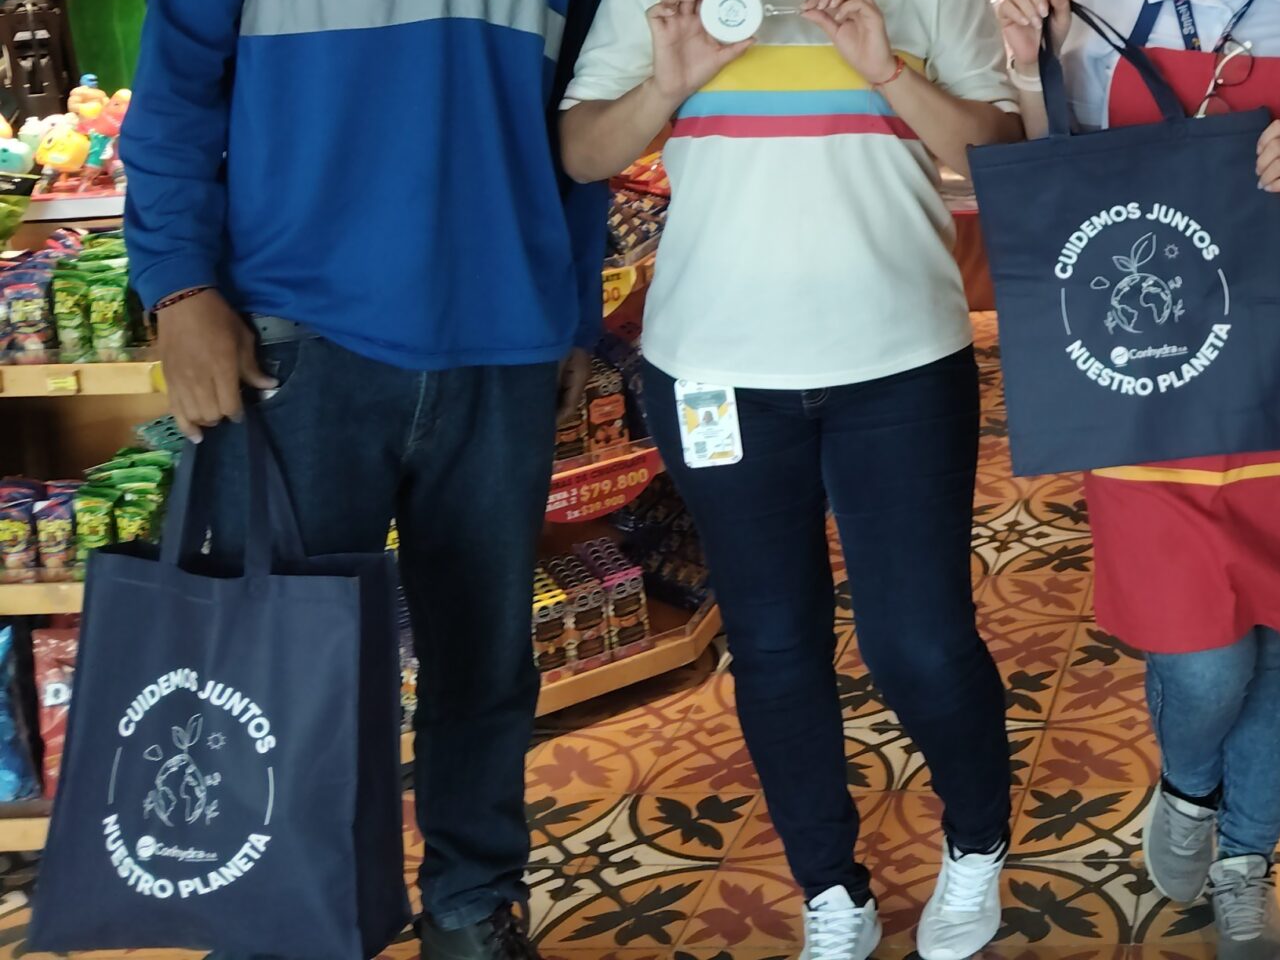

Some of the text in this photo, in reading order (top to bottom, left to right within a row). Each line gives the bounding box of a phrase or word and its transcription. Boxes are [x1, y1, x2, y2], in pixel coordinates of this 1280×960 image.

[1054, 201, 1220, 280] CUIDEMOS JUNTOS
[1065, 323, 1232, 397] NUESTRO PLANETA
[1127, 343, 1178, 360] Conhydra
[579, 468, 649, 502] $79.800
[197, 680, 277, 755] JUNTOS
[102, 813, 272, 899] NUESTRO PLANETA
